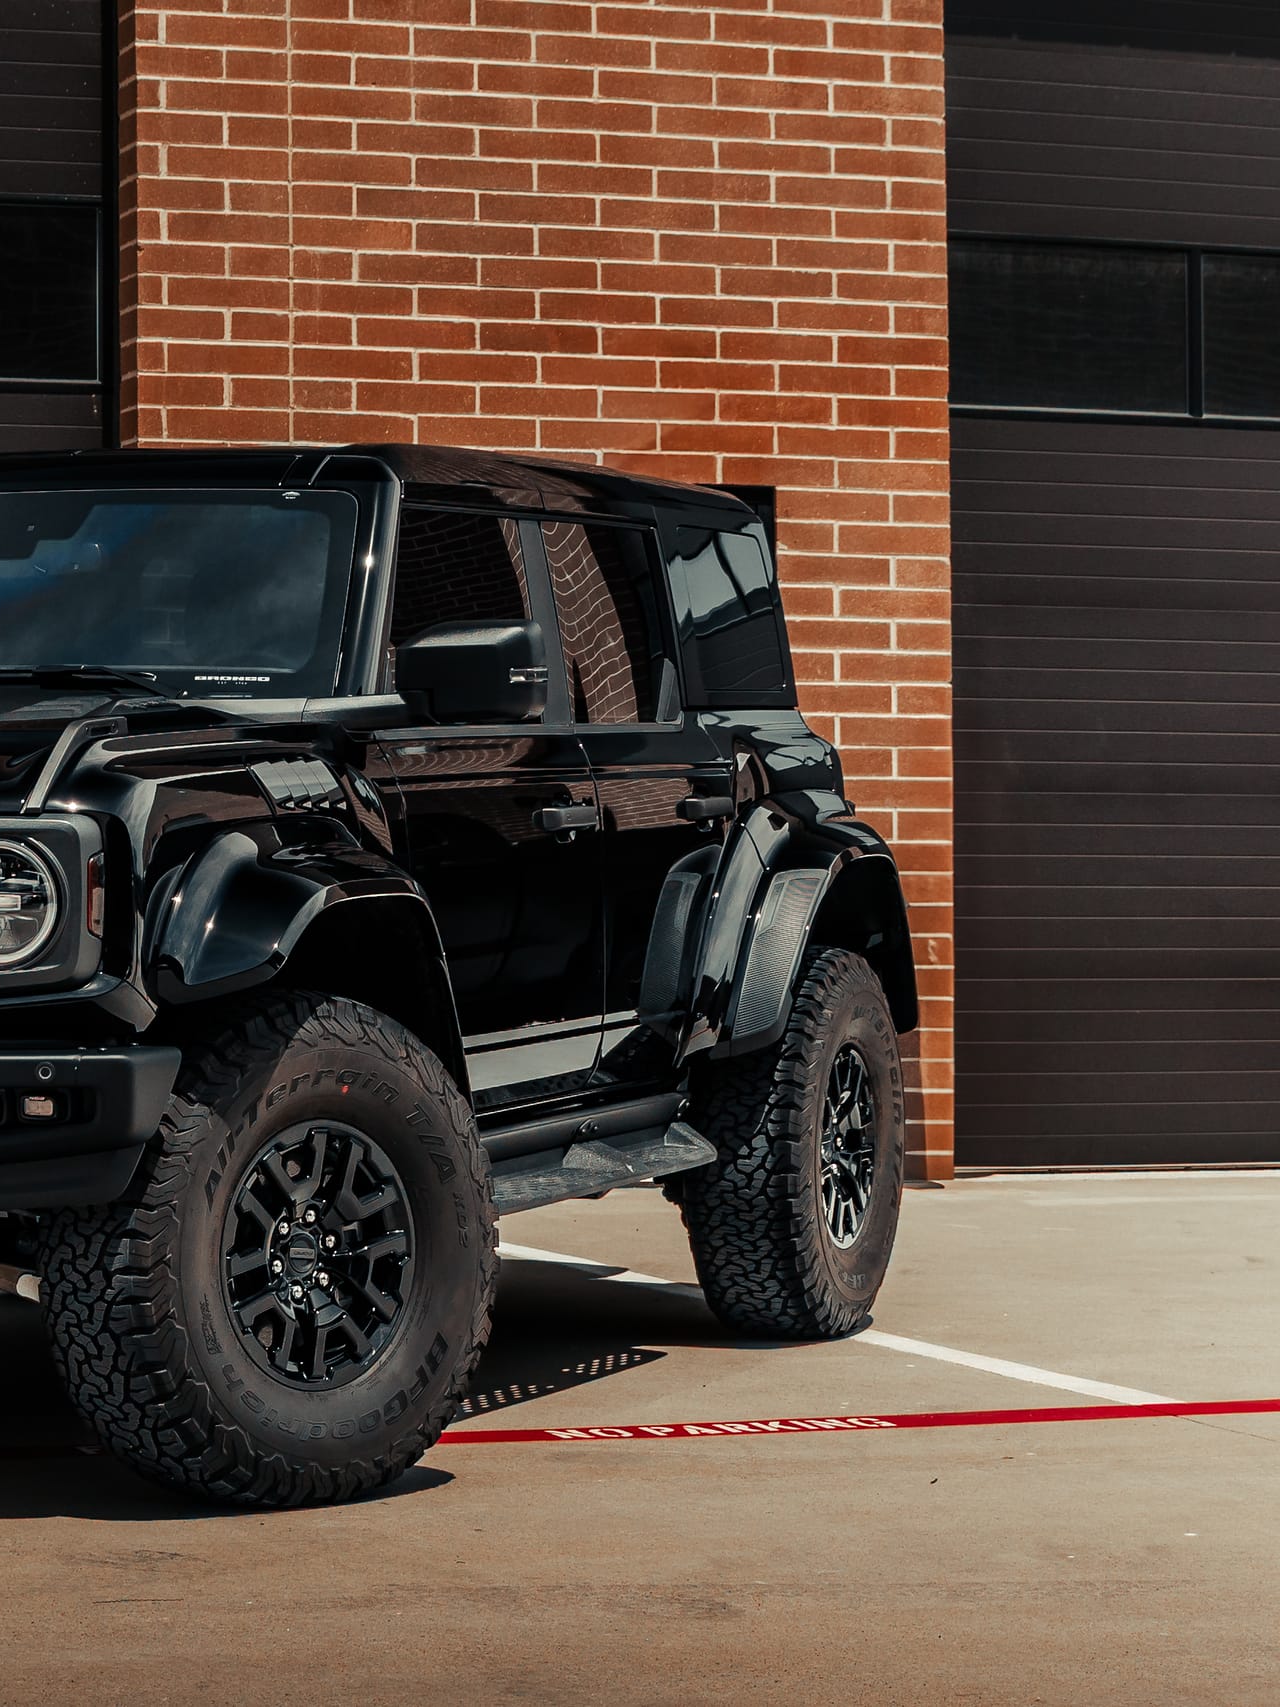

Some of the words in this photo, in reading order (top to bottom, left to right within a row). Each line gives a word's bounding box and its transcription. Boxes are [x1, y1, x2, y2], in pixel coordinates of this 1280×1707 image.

[204, 1068, 401, 1213] All-Terrain
[545, 1427, 634, 1440] NO
[638, 1417, 898, 1438] PARKING
